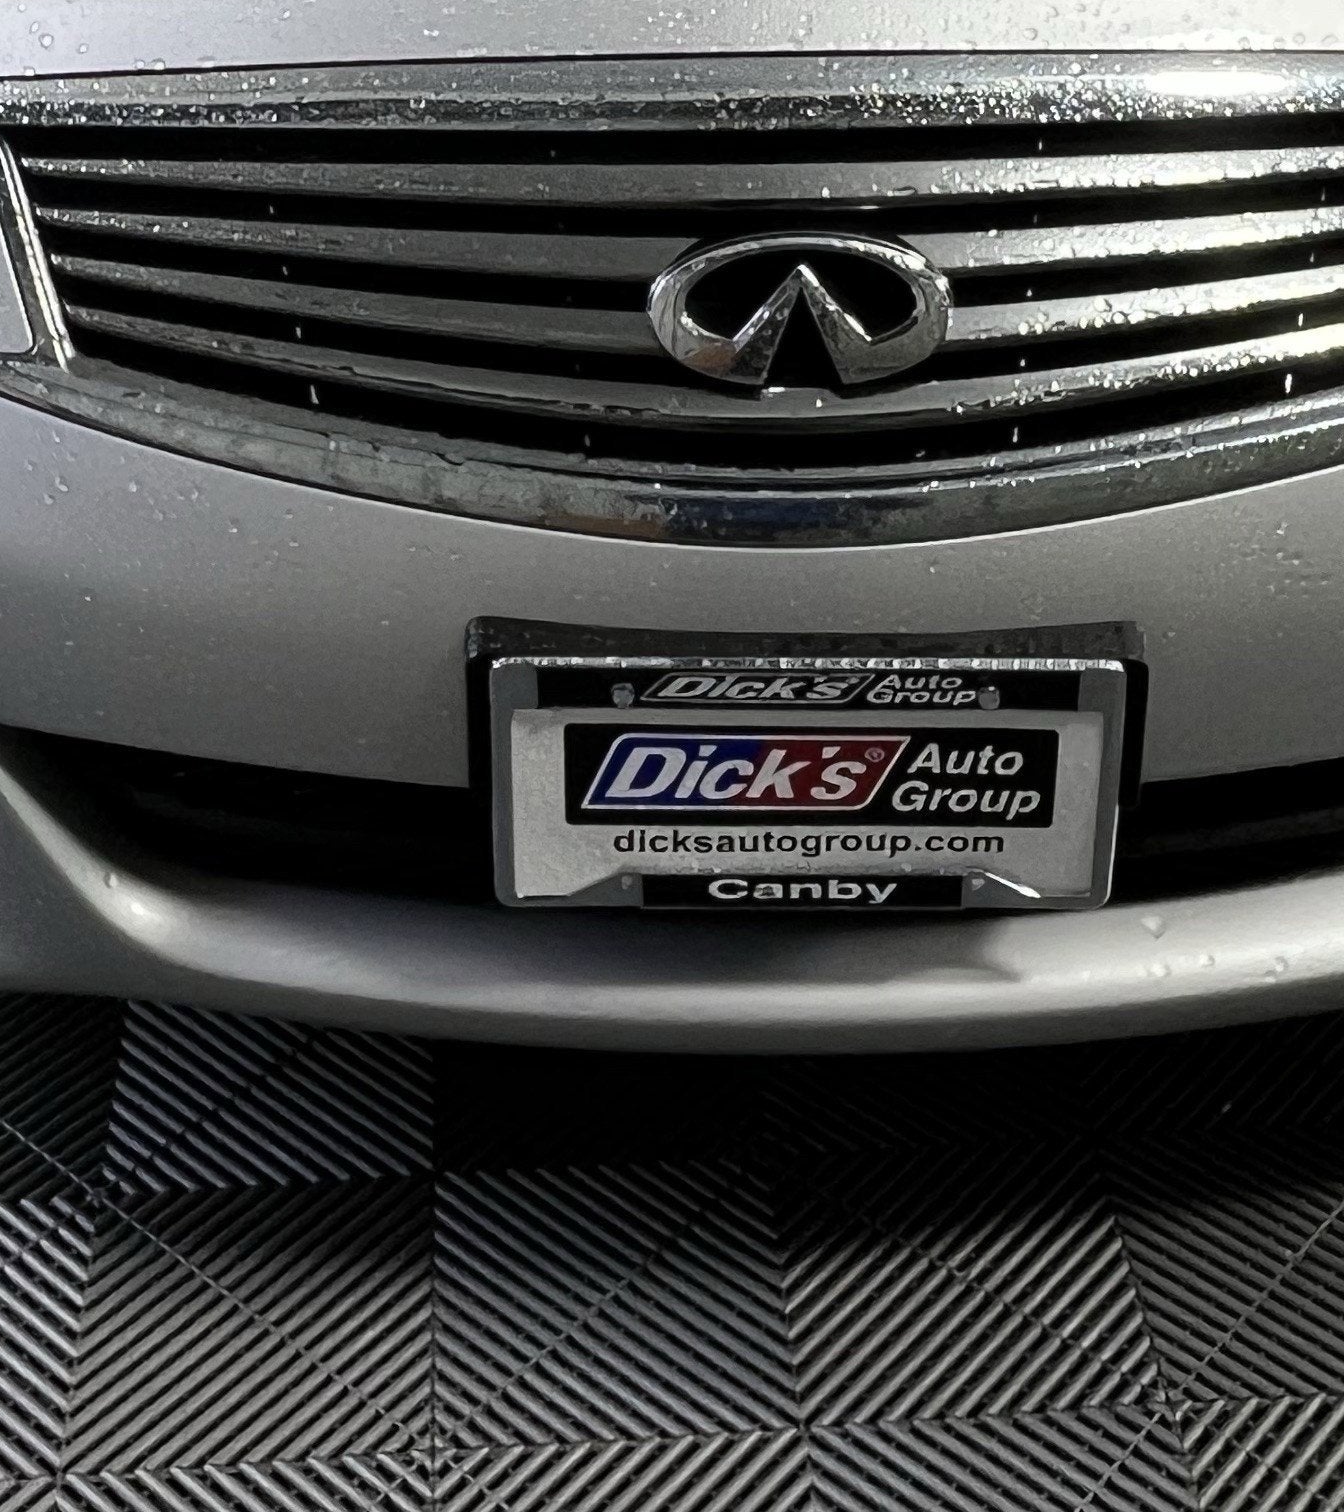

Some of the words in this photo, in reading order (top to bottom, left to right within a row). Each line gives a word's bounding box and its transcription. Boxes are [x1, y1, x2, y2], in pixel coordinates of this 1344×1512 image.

[657, 675, 852, 701] Dick's
[866, 687, 976, 705] Group
[878, 674, 964, 690] Auto
[605, 744, 868, 800] Dick's
[907, 742, 1025, 776] Auto
[892, 780, 1042, 821] Group
[613, 829, 1005, 859] dicksautogroup.com
[708, 877, 898, 904] Canby
